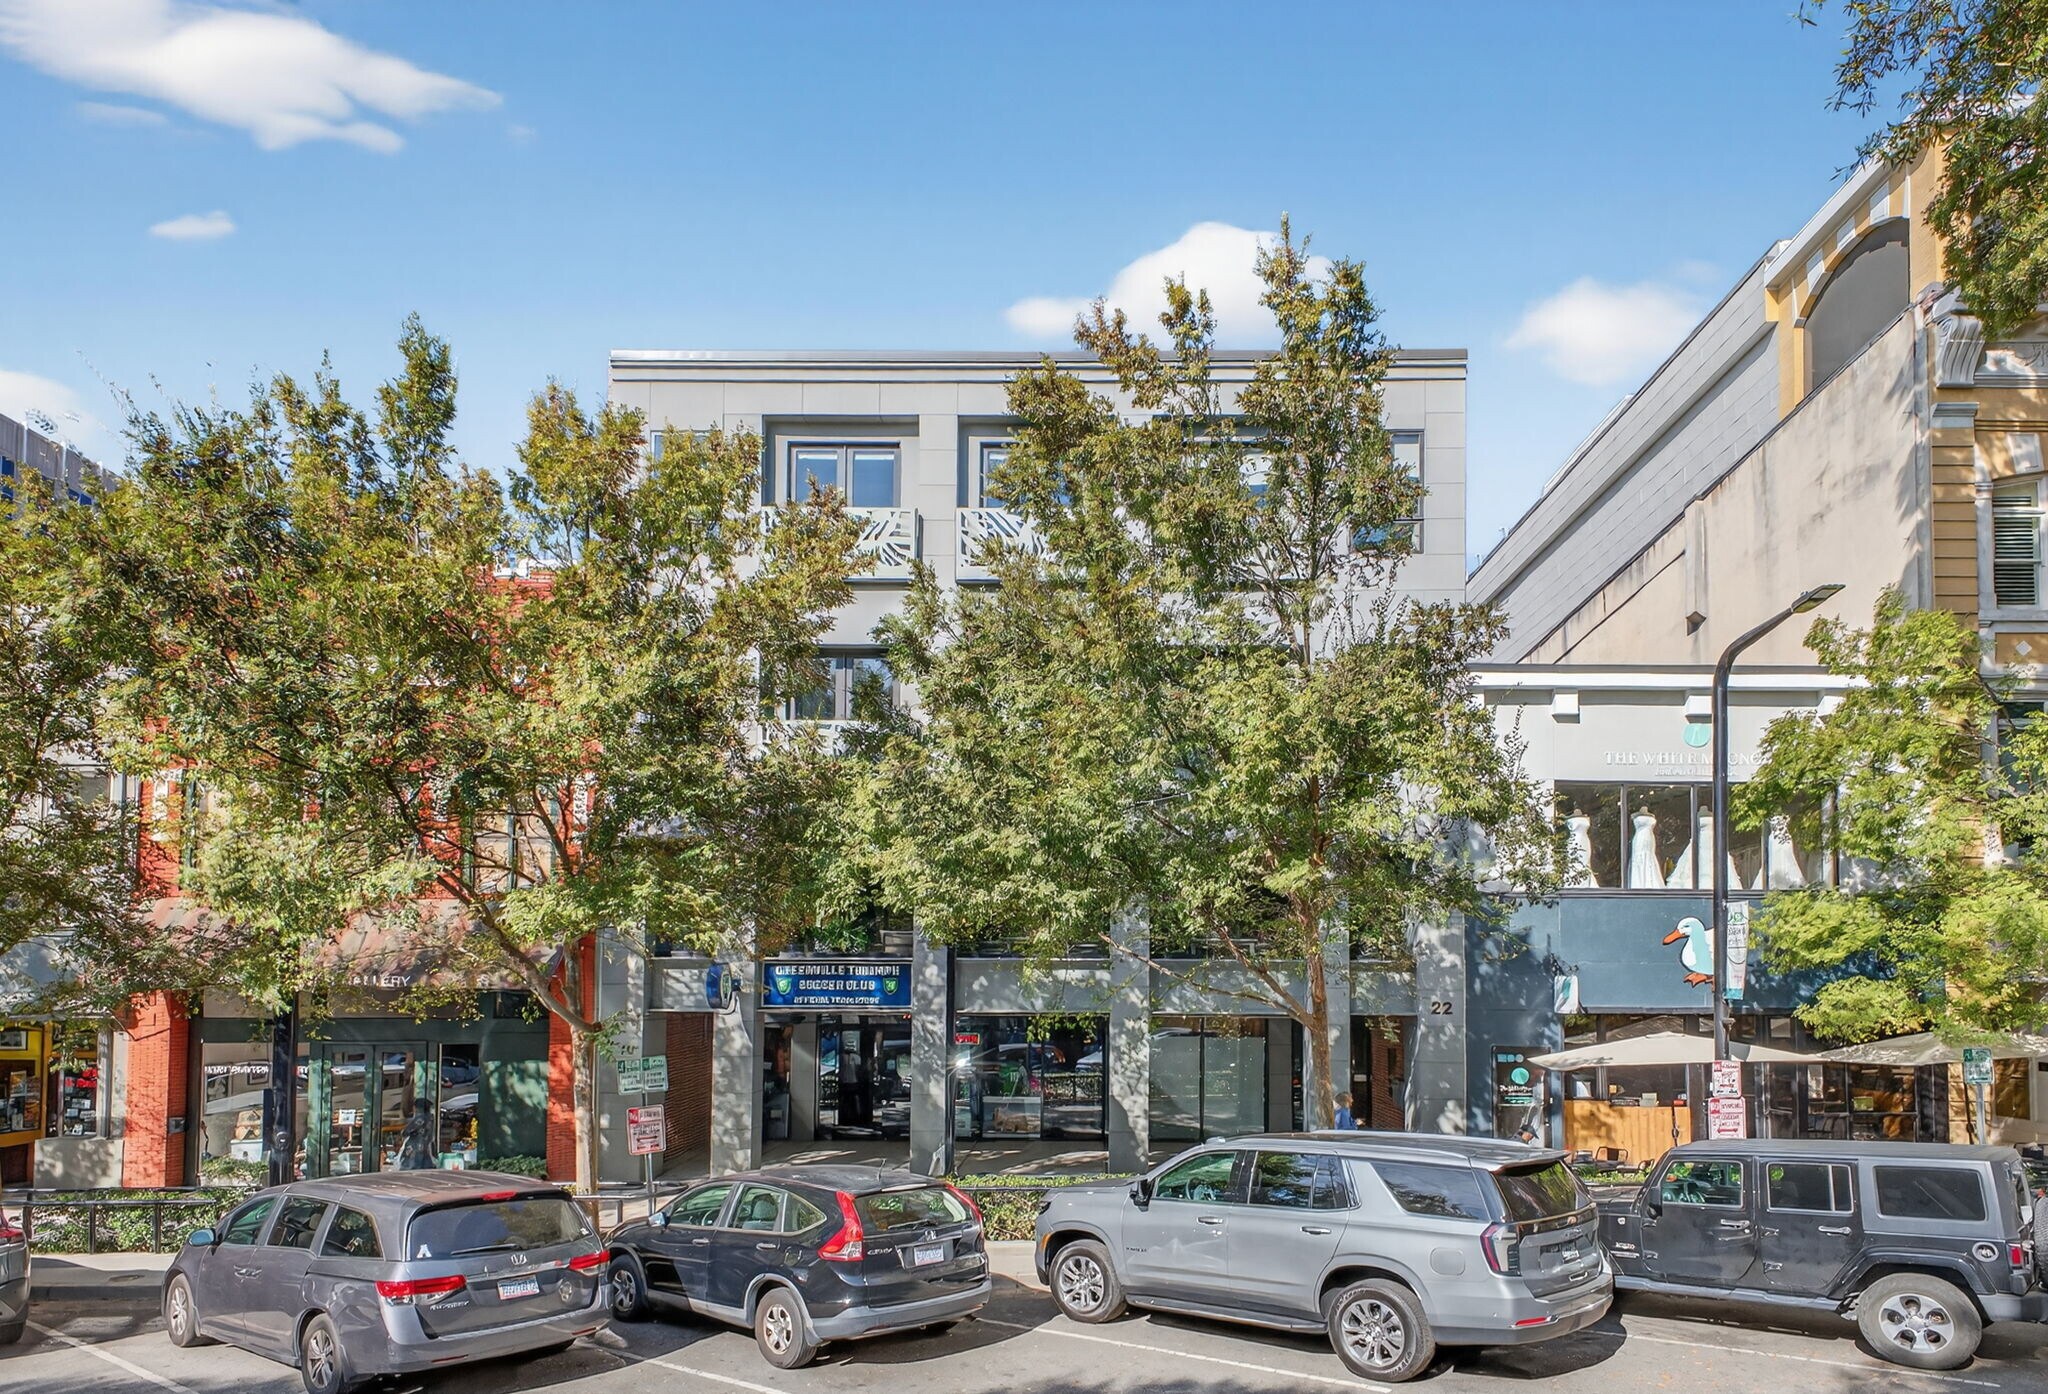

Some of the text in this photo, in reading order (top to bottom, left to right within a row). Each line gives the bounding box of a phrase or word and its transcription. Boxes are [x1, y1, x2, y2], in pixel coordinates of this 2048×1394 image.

[1604, 751, 1639, 766] THE
[1643, 751, 1697, 766] WHITE
[1431, 1001, 1453, 1015] 22
